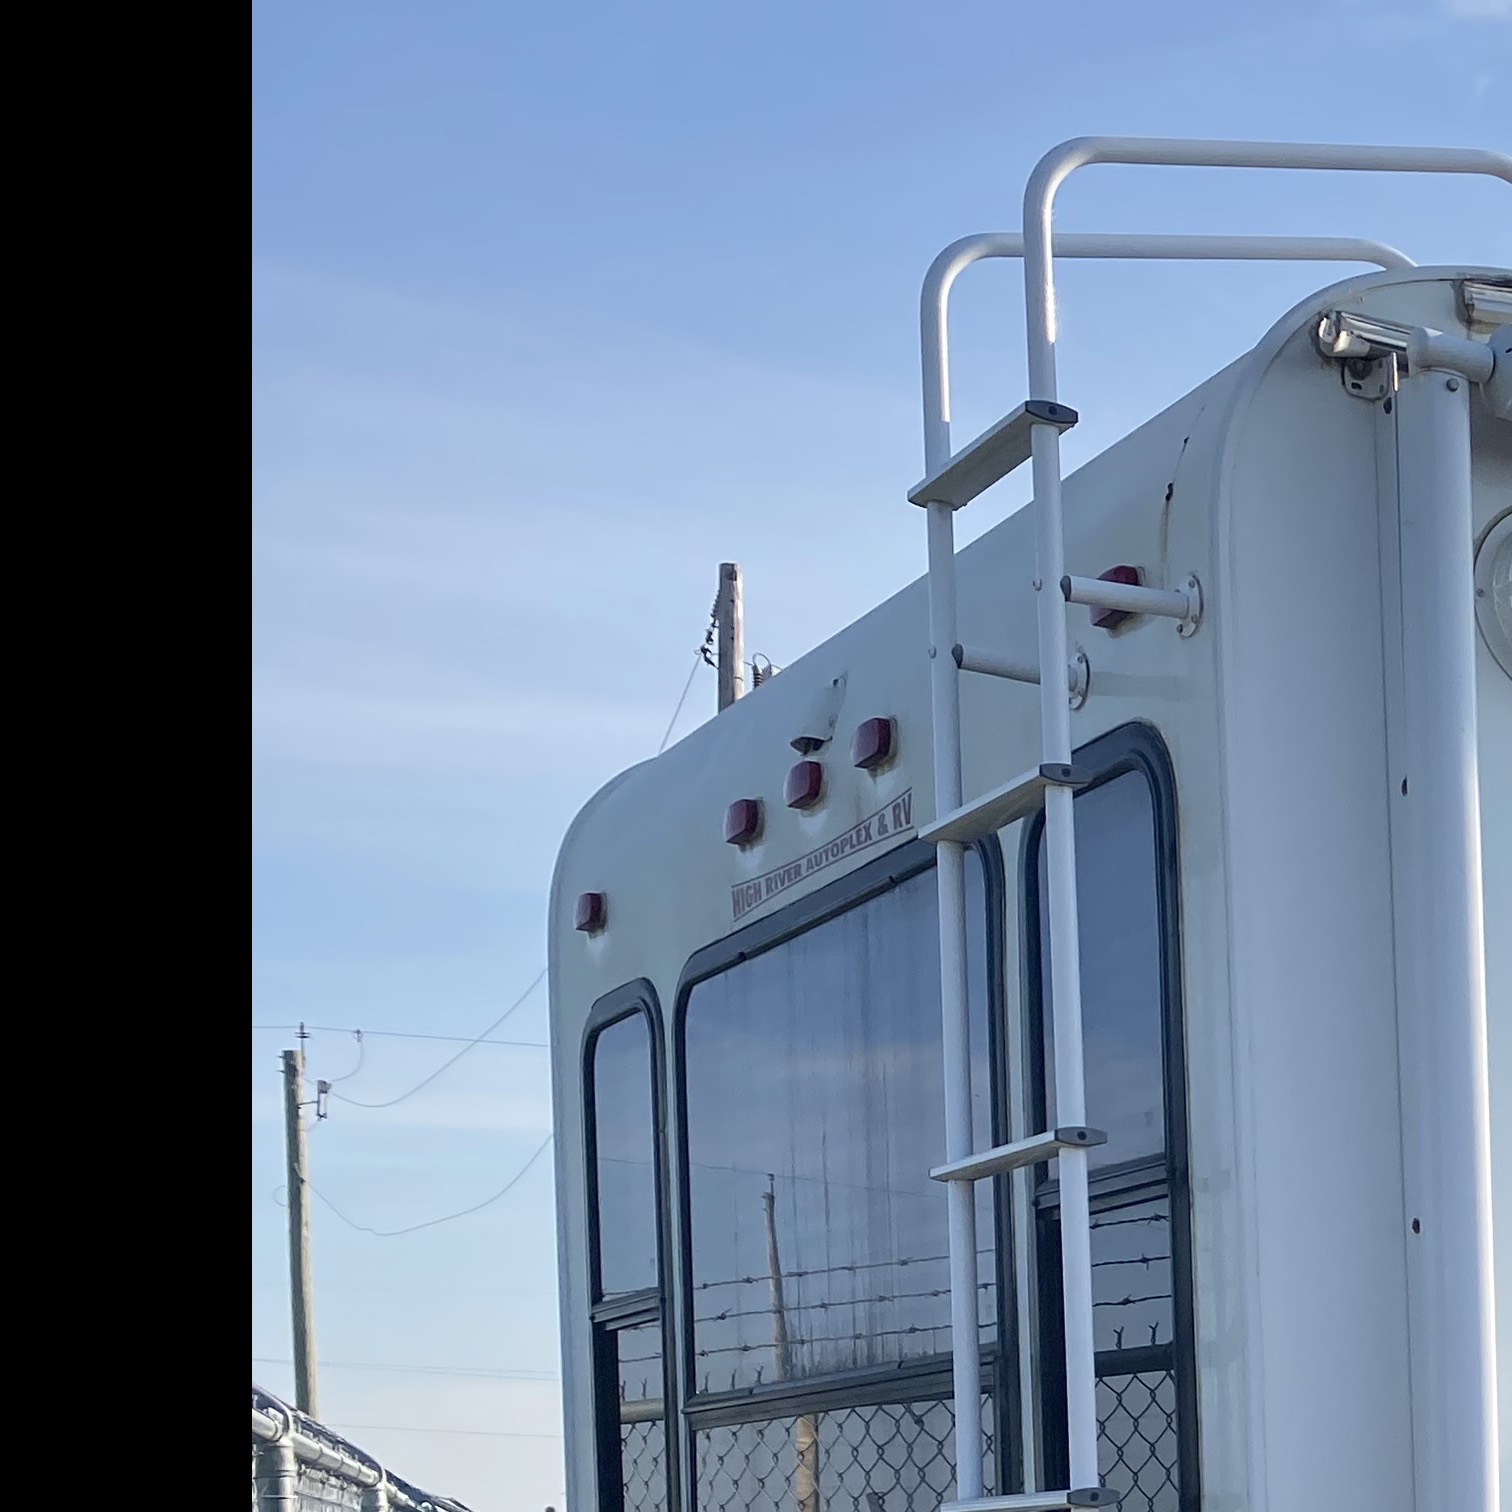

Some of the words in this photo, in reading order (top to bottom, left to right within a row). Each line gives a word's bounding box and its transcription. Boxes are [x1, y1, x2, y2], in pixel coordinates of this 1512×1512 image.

[731, 880, 762, 918] HIGH
[765, 863, 803, 896] RIVER
[805, 820, 873, 873] AUTOPLEX
[877, 812, 889, 836] &
[892, 792, 912, 830] RV
